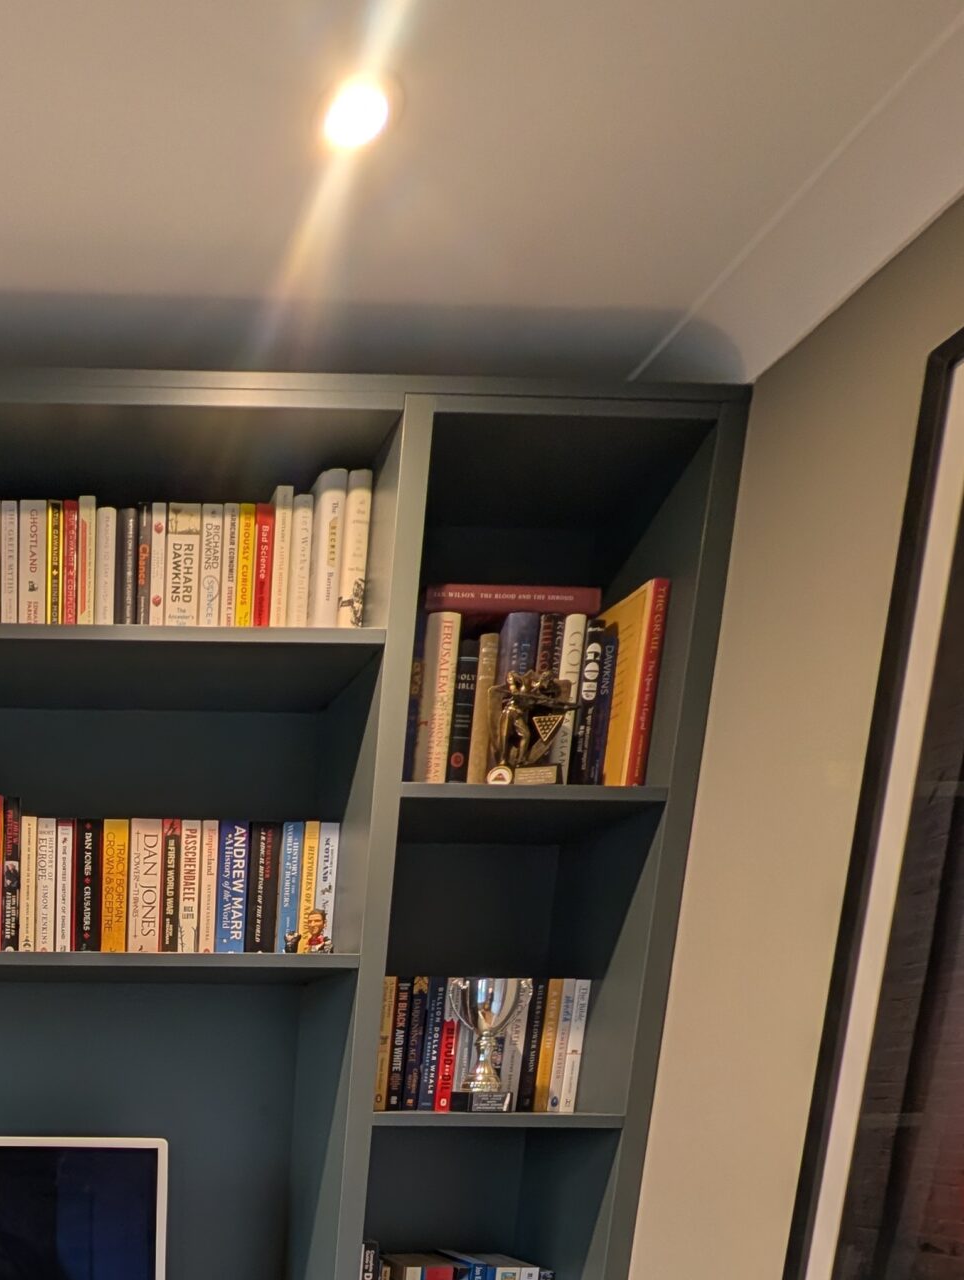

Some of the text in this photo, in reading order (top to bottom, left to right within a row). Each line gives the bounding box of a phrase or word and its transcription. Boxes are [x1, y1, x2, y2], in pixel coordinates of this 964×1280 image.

[331, 501, 339, 514] The
[28, 508, 38, 574] GHOSTLAND
[138, 544, 150, 586] Chance
[204, 522, 213, 570] DAWKINS
[211, 524, 220, 569] RICHARD
[228, 548, 236, 582] ECONOMIST
[240, 511, 251, 606] SERIOUSLY CURIOUS
[258, 525, 270, 579] Bad Science
[171, 542, 183, 602] DAWKINS
[182, 543, 195, 604] RICHARD
[325, 572, 334, 602] Barrister
[206, 580, 215, 618] SCIENCE
[650, 586, 668, 650] THE GRAIL
[437, 619, 454, 694] JERUSALEM
[582, 642, 602, 701] GOD
[600, 644, 614, 695] DAWKINS
[432, 713, 444, 782] SIMON SEBAG
[560, 730, 570, 768] ASLAN
[38, 838, 46, 880] EUROPE
[84, 832, 92, 876] DAN JONES
[182, 828, 198, 902] PASSCHENDAELE
[206, 828, 215, 876] Empireland
[291, 842, 300, 876] HISTORY
[322, 837, 331, 882] SCOTLAND
[104, 832, 115, 932] CROWN & SCEPTRE
[114, 842, 126, 923] TRACY BORMAN
[140, 833, 158, 937] DAN JONES
[166, 846, 176, 914] FIRST WORLD WAR
[230, 825, 246, 940] ANDREW MARR
[83, 886, 92, 930] CRUSADERS
[392, 992, 408, 1072] IN BLACK AND WHITE
[427, 987, 444, 1095] BILLION DOLLAR WHALE
[442, 1027, 456, 1064] BLOOD
[511, 1018, 522, 1046] EARTH
[440, 1074, 453, 1091] OIL
